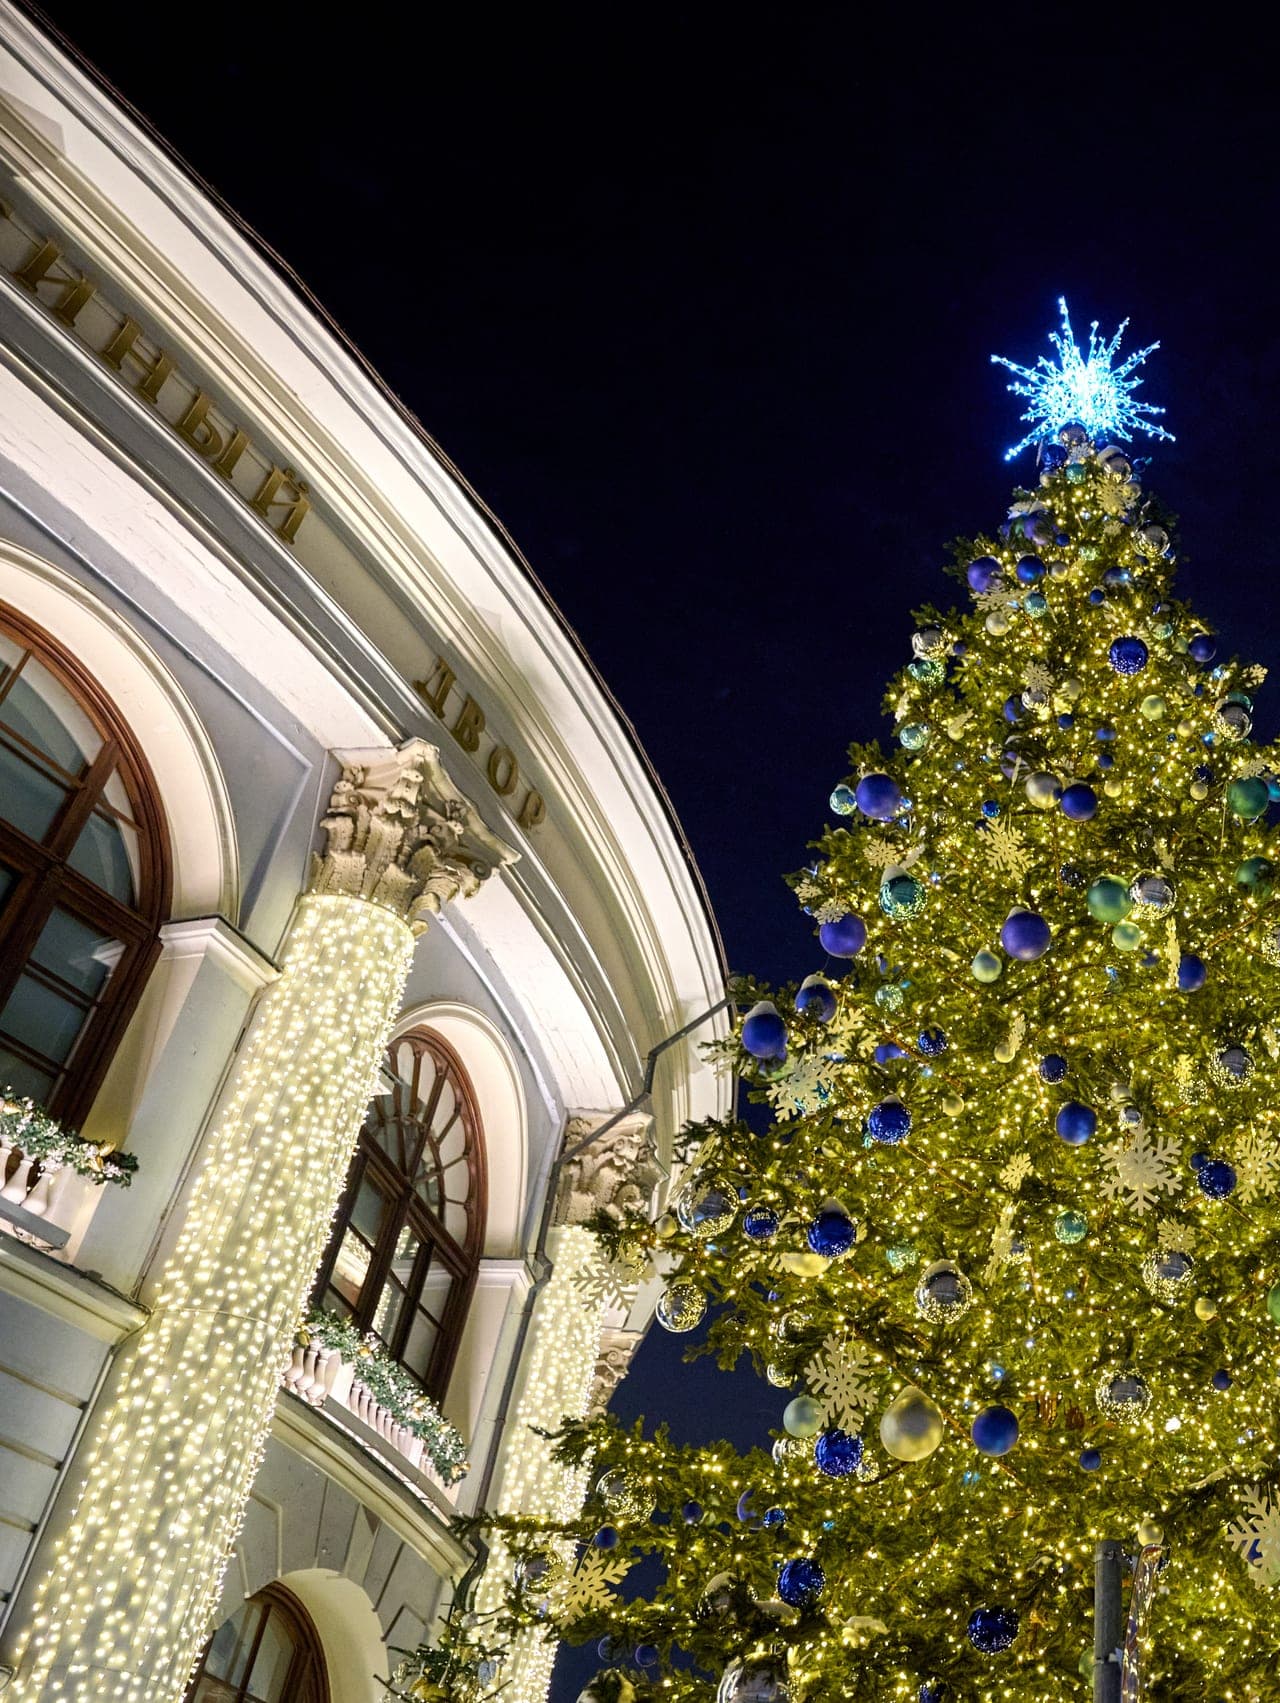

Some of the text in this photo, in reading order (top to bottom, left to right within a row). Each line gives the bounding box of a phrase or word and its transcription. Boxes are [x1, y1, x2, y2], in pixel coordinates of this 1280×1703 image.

[0, 198, 546, 830] ИНЫЙ ДВОР
[752, 1212, 770, 1221] 2025
